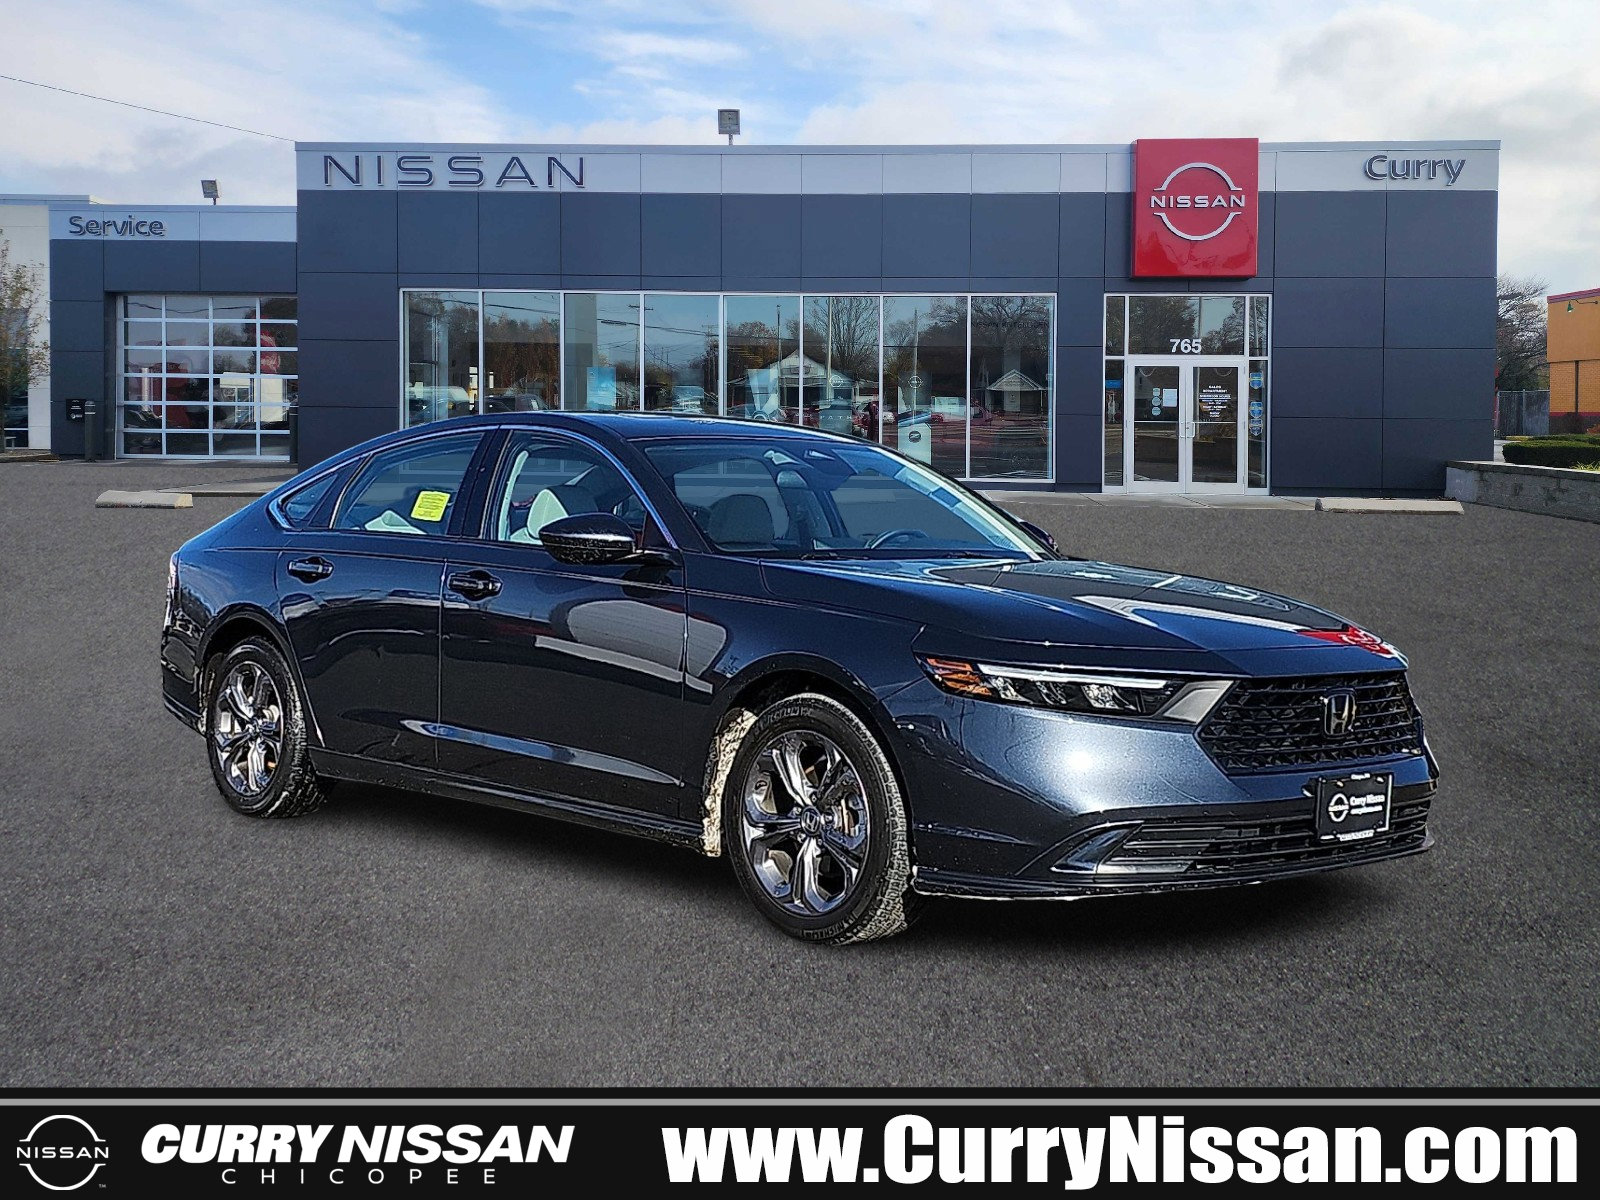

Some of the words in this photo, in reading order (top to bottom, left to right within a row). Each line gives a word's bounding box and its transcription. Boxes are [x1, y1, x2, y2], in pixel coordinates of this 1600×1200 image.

[323, 154, 585, 189] NISSAN
[1364, 154, 1466, 186] Curry
[1150, 194, 1246, 209] NISSAN
[68, 214, 165, 237] Service
[1169, 338, 1202, 353] 765
